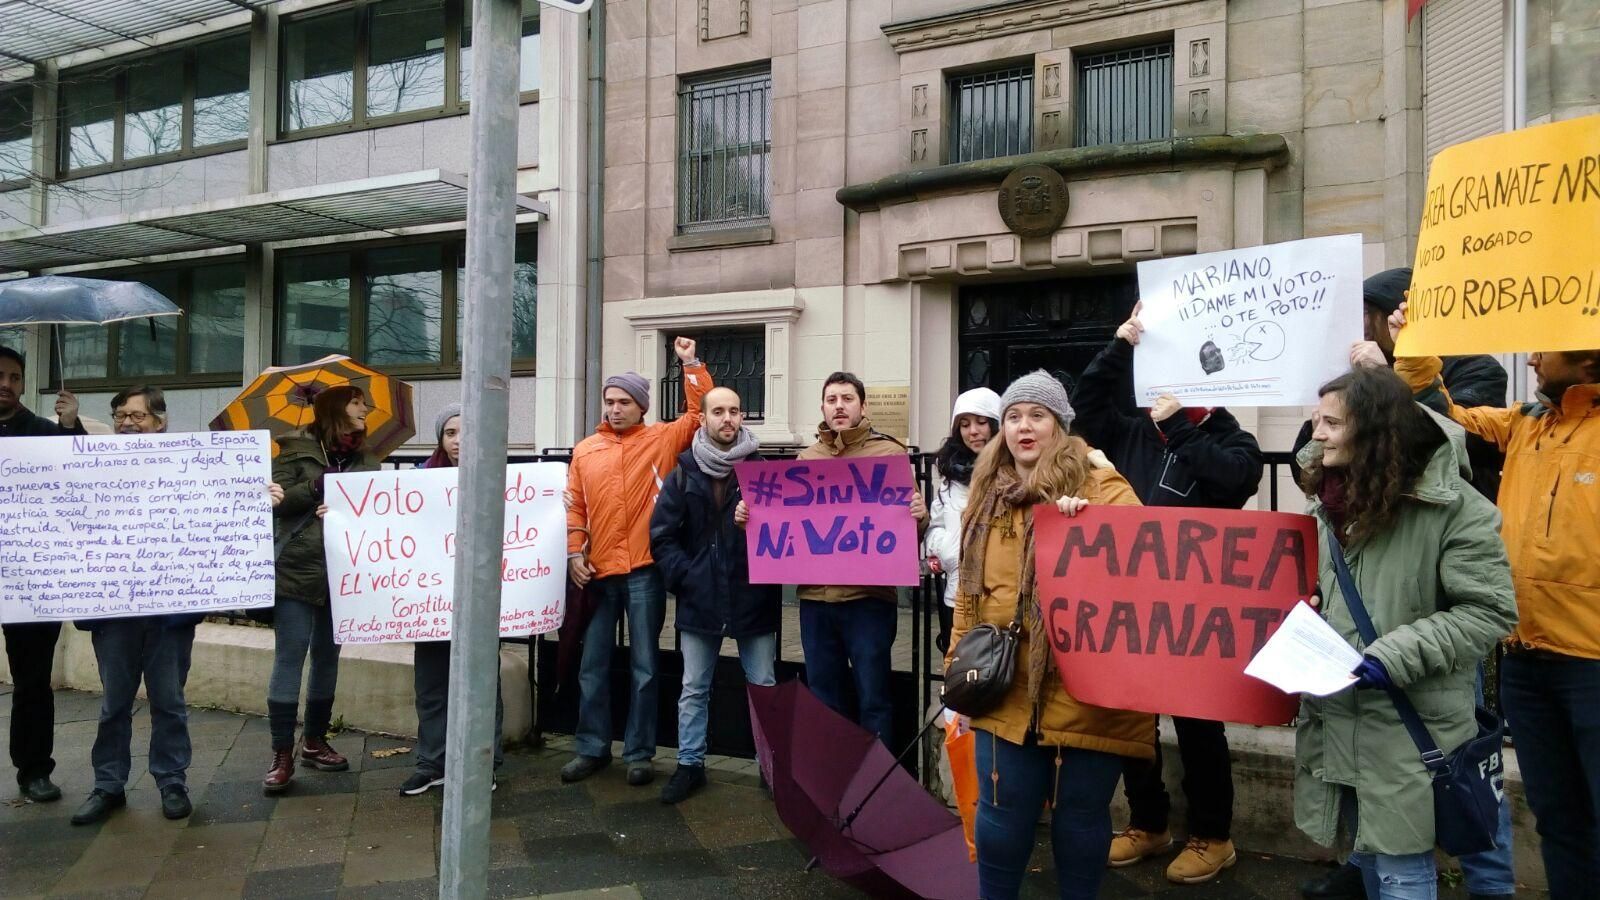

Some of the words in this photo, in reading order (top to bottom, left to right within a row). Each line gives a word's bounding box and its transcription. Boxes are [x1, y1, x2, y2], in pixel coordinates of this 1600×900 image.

[1450, 162, 1552, 220] GRANATE
[1552, 153, 1600, 205] NR
[1419, 244, 1446, 269] VOTO
[1461, 230, 1533, 257] ROGADO
[1172, 256, 1273, 301] MARIANO,
[1243, 286, 1267, 302] MI
[1238, 309, 1259, 322] TE
[72, 435, 121, 454] Nueva
[123, 438, 156, 451] sabia
[210, 432, 260, 449] España
[0, 458, 57, 477] Gobierno:
[130, 458, 141, 468] a
[177, 457, 189, 473] y
[191, 450, 230, 470] dejad
[235, 453, 263, 472] que
[15, 480, 61, 491] nuevas
[64, 478, 156, 495] generaciones
[157, 476, 197, 493] hagan
[202, 478, 228, 487] una
[230, 475, 266, 486] nueva
[94, 492, 112, 503] No
[113, 491, 141, 503] más
[213, 491, 231, 500] no
[234, 488, 263, 499] más
[336, 476, 424, 518] Voto
[202, 502, 229, 514] más
[251, 515, 267, 527] de
[126, 534, 169, 547] Europa
[344, 527, 417, 568] Voto
[755, 521, 795, 560] Ni
[801, 515, 897, 555] Voto
[85, 550, 103, 560] Es
[105, 551, 133, 564] para
[210, 548, 218, 562] y
[1053, 518, 1308, 595] MAREA
[118, 565, 129, 574] a
[417, 570, 443, 589] es
[26, 578, 55, 591] tarde
[55, 578, 98, 590] tenemos
[37, 590, 106, 604] desaparezca
[176, 583, 219, 597] actual
[338, 617, 355, 634] El
[357, 614, 383, 633] voto
[384, 614, 429, 634] rogado
[432, 617, 447, 626] es
[541, 599, 560, 616] del
[1049, 596, 1291, 659] GRANAT
